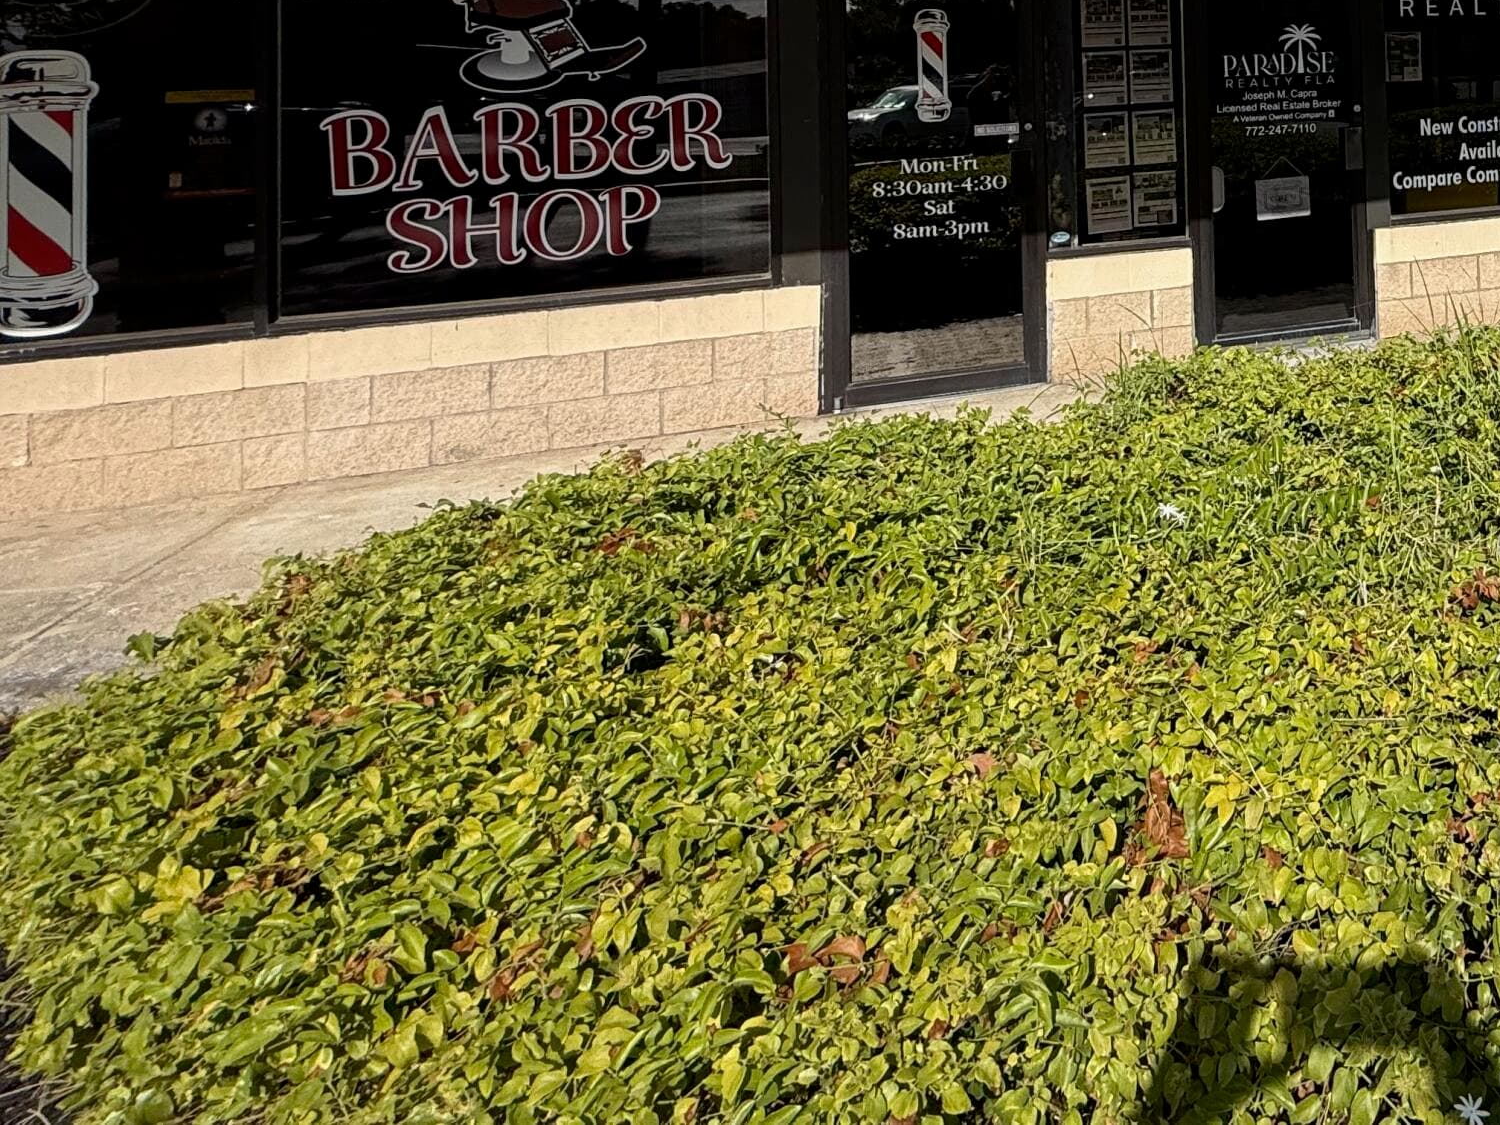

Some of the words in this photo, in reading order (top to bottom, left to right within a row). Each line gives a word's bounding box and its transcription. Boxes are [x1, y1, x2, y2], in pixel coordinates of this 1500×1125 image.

[1224, 51, 1335, 77] PARADISE
[1225, 77, 1292, 88] REALTY
[1305, 75, 1335, 85] FLA
[1242, 90, 1274, 101] Joseph
[1290, 89, 1317, 99] Capra
[1216, 104, 1257, 114] Licensed
[1260, 102, 1280, 111] Real
[1283, 101, 1310, 110] Estate
[1312, 100, 1341, 108] Broker
[1245, 123, 1317, 136] 772-247-7110
[1419, 118, 1453, 137] New
[319, 93, 732, 196] BARBER
[899, 156, 979, 175] Mon-Fri
[872, 175, 1007, 198] 8:30am-4:30
[1392, 171, 1462, 191] Compare
[924, 200, 956, 216] Sat
[386, 184, 661, 274] SHOP
[893, 219, 990, 240] 8am-3pm
